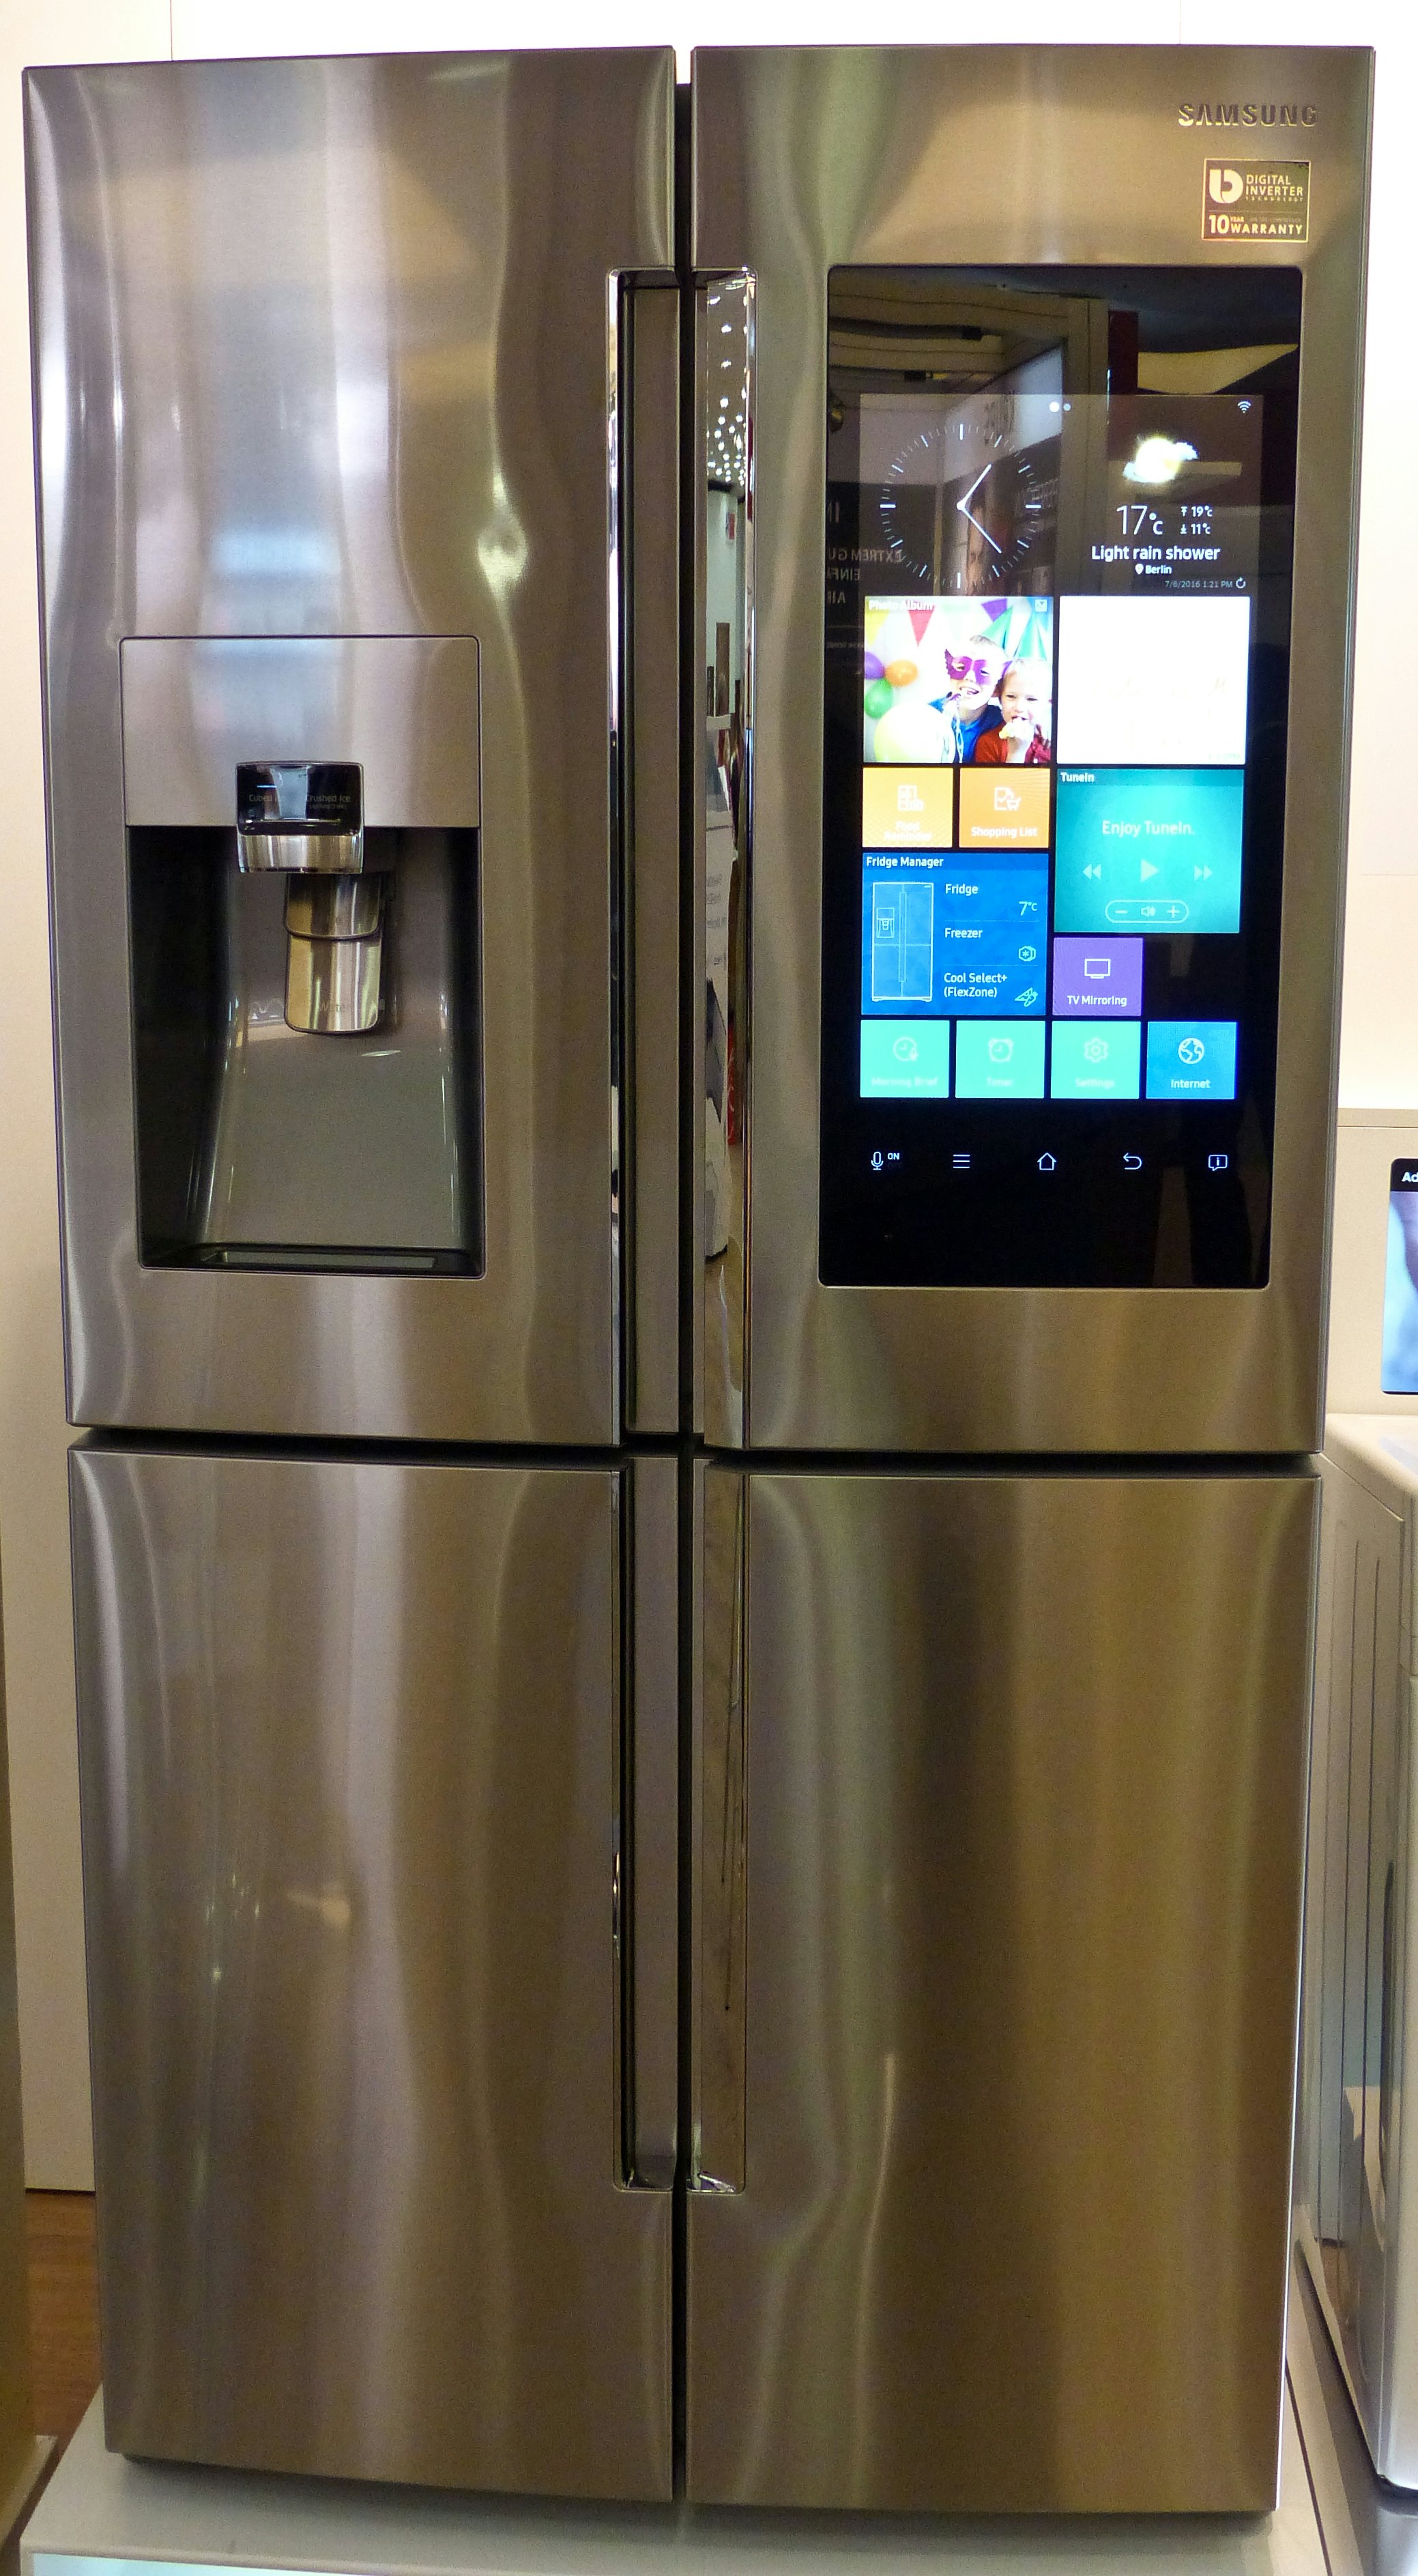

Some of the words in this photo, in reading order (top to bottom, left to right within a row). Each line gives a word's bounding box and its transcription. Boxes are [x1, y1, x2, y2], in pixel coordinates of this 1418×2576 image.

[1178, 103, 1318, 127] SAMSUNG
[1246, 174, 1291, 185] DIGITAL
[1245, 186, 1303, 197] INVERTER
[1209, 214, 1229, 234] 10
[1231, 224, 1303, 234] WARRANTY
[1092, 545, 1129, 562] Light
[1133, 545, 1161, 560] rain
[1166, 545, 1221, 560] shower
[1145, 565, 1172, 575] Berlin
[900, 600, 934, 611] Album
[971, 827, 1017, 839] Shopping
[1019, 827, 1037, 837] List
[1101, 820, 1141, 837] Enjoy
[866, 856, 898, 869] Fridge
[900, 856, 944, 869] Manager
[945, 884, 979, 896] Fridge
[944, 927, 983, 938] Freezer
[944, 972, 966, 983] Cool
[969, 972, 1008, 983] Select+
[944, 987, 997, 998] (FlexZone)
[1067, 996, 1080, 1004] TV
[1082, 995, 1127, 1007] Mirroring
[1171, 1079, 1211, 1088] Internet
